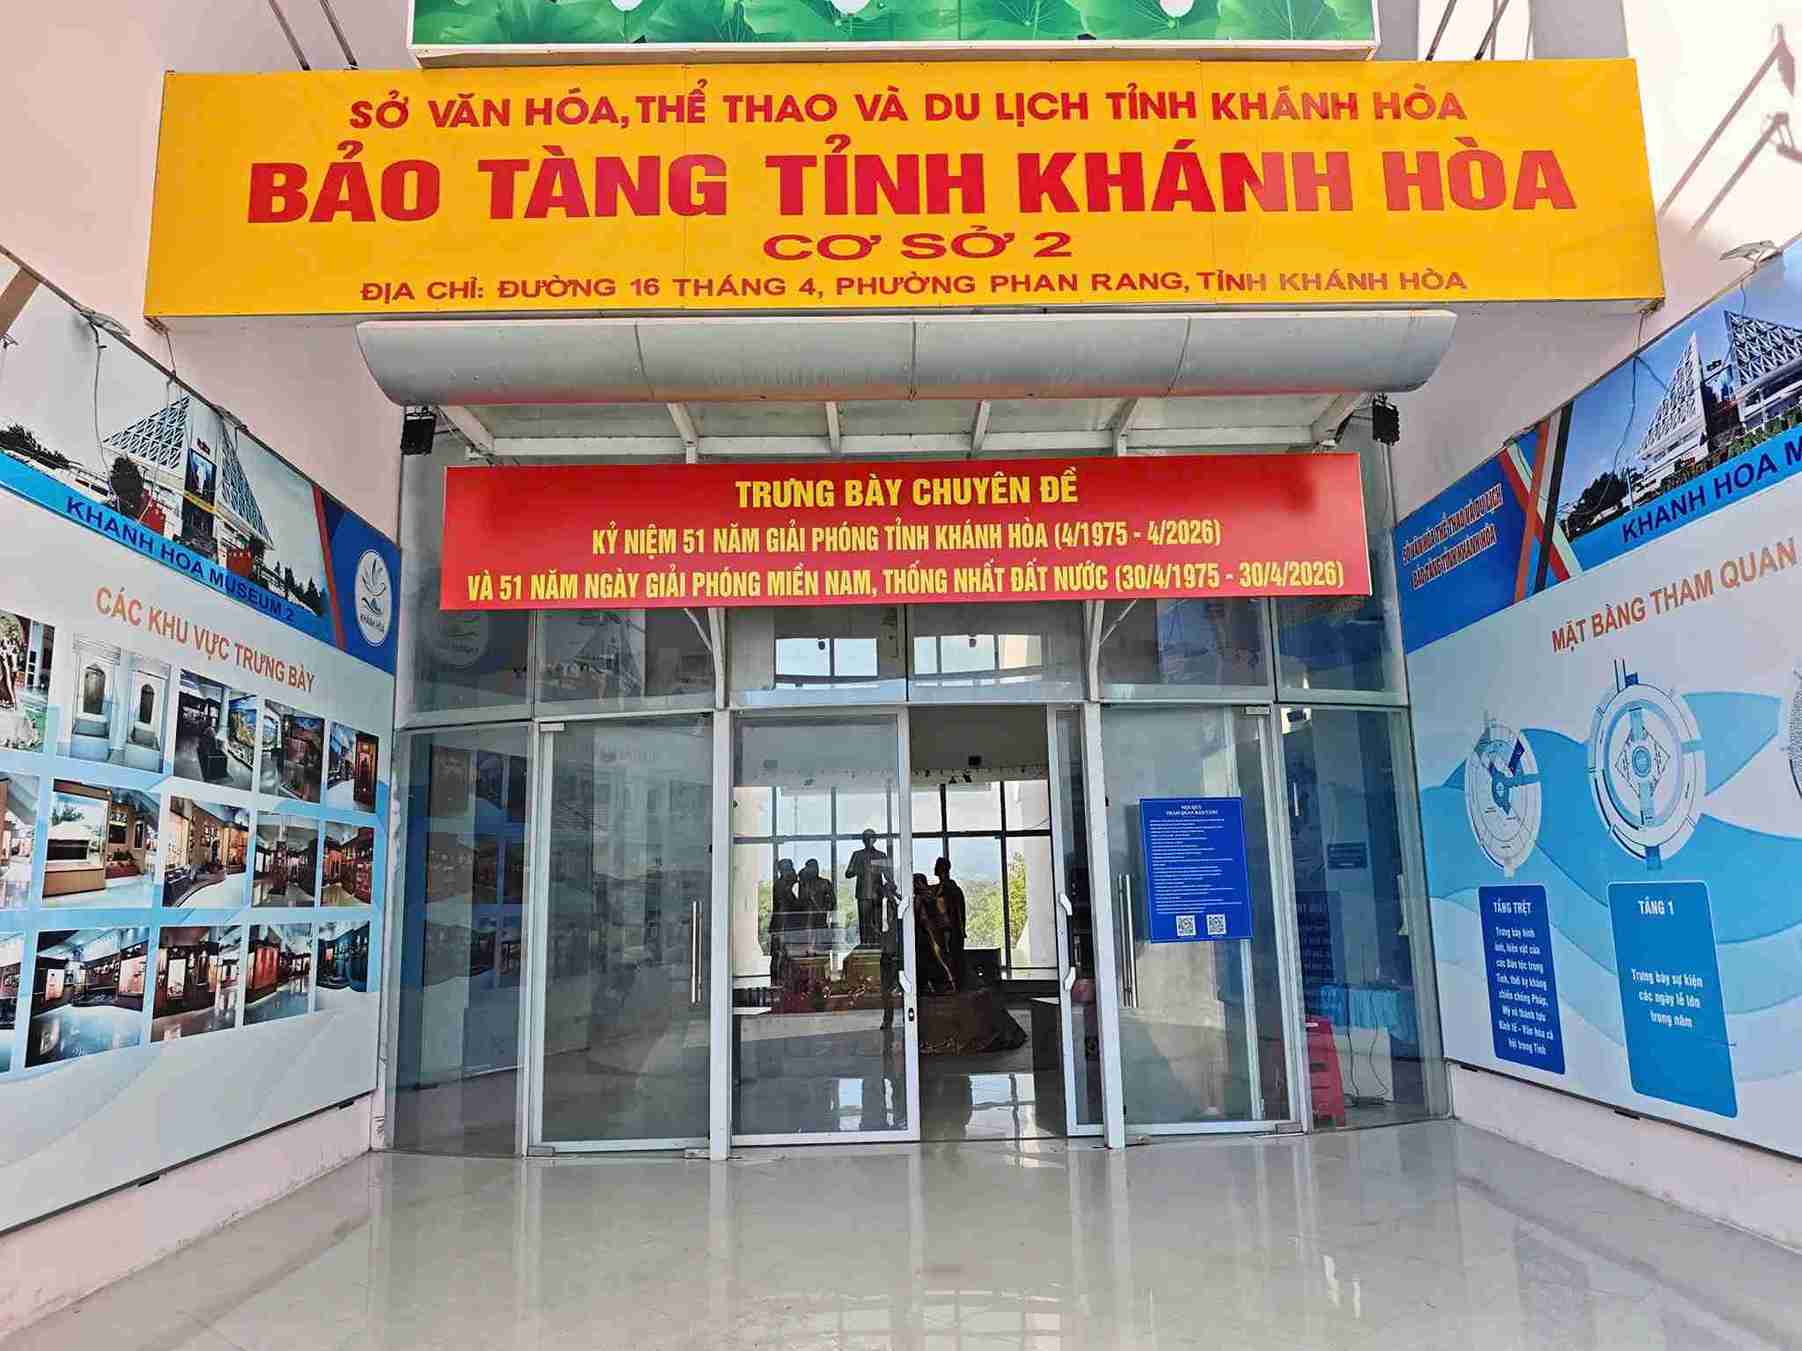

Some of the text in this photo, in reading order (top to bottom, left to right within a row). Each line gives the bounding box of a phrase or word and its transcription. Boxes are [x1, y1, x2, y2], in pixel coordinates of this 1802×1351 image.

[350, 79, 1467, 130] SỞ VĂN HÓA, THỂ THAO VÀ DU LỊCH TỈNH KHÁNH HÒA
[248, 134, 1576, 223] BẢO TÀNG TỈNH KHÁNH HÒA
[763, 225, 1072, 260] CƠ SỞ 2
[360, 268, 1467, 304] ĐỊA CHỈ: ĐƯỜNG 16 THÁNG 4, PHƯỜNG PHAN RANG, TỈNH KHÁNH HÒA
[735, 467, 1078, 508] TRƯNG BÀY CHUYÊN ĐỀ
[1622, 485, 1706, 543] KHANH
[1713, 453, 1778, 500] HOA
[67, 497, 296, 621] KHANH HOA MUSEUM 2
[593, 521, 618, 555] KỶ
[624, 524, 677, 559] NIỆM
[683, 529, 705, 554] 51
[714, 523, 760, 553] NĂM
[767, 520, 805, 552] GIẢI
[812, 520, 879, 552] PHÓNG
[884, 515, 929, 552] TỈNH
[935, 519, 1001, 550] KHÁNH
[1008, 517, 1048, 549] HÒA
[1055, 520, 1128, 550] (4/1975
[1148, 519, 1221, 546] 4/2026)
[467, 570, 493, 601] VÀ
[500, 576, 522, 600] 51
[531, 570, 578, 600] NĂM
[585, 568, 639, 600] NGÀY
[646, 564, 685, 598] GIẢI
[692, 566, 760, 598] PHÓNG
[768, 562, 818, 597] MIỀN
[825, 569, 878, 599] NAM,
[883, 560, 947, 594] THỐNG
[954, 558, 1005, 593] NHẤT
[1011, 558, 1048, 592] ĐẤT
[1054, 560, 1108, 592] NƯỚC
[1115, 563, 1220, 592] (30/4/1975
[1239, 560, 1344, 590] 30/4/2026)
[1649, 569, 1713, 614] THAM
[1720, 536, 1798, 588] QUAN
[96, 587, 315, 693] CÁC KHU VỰC TRƯNG BÀY
[1668, 900, 1674, 915] 1
